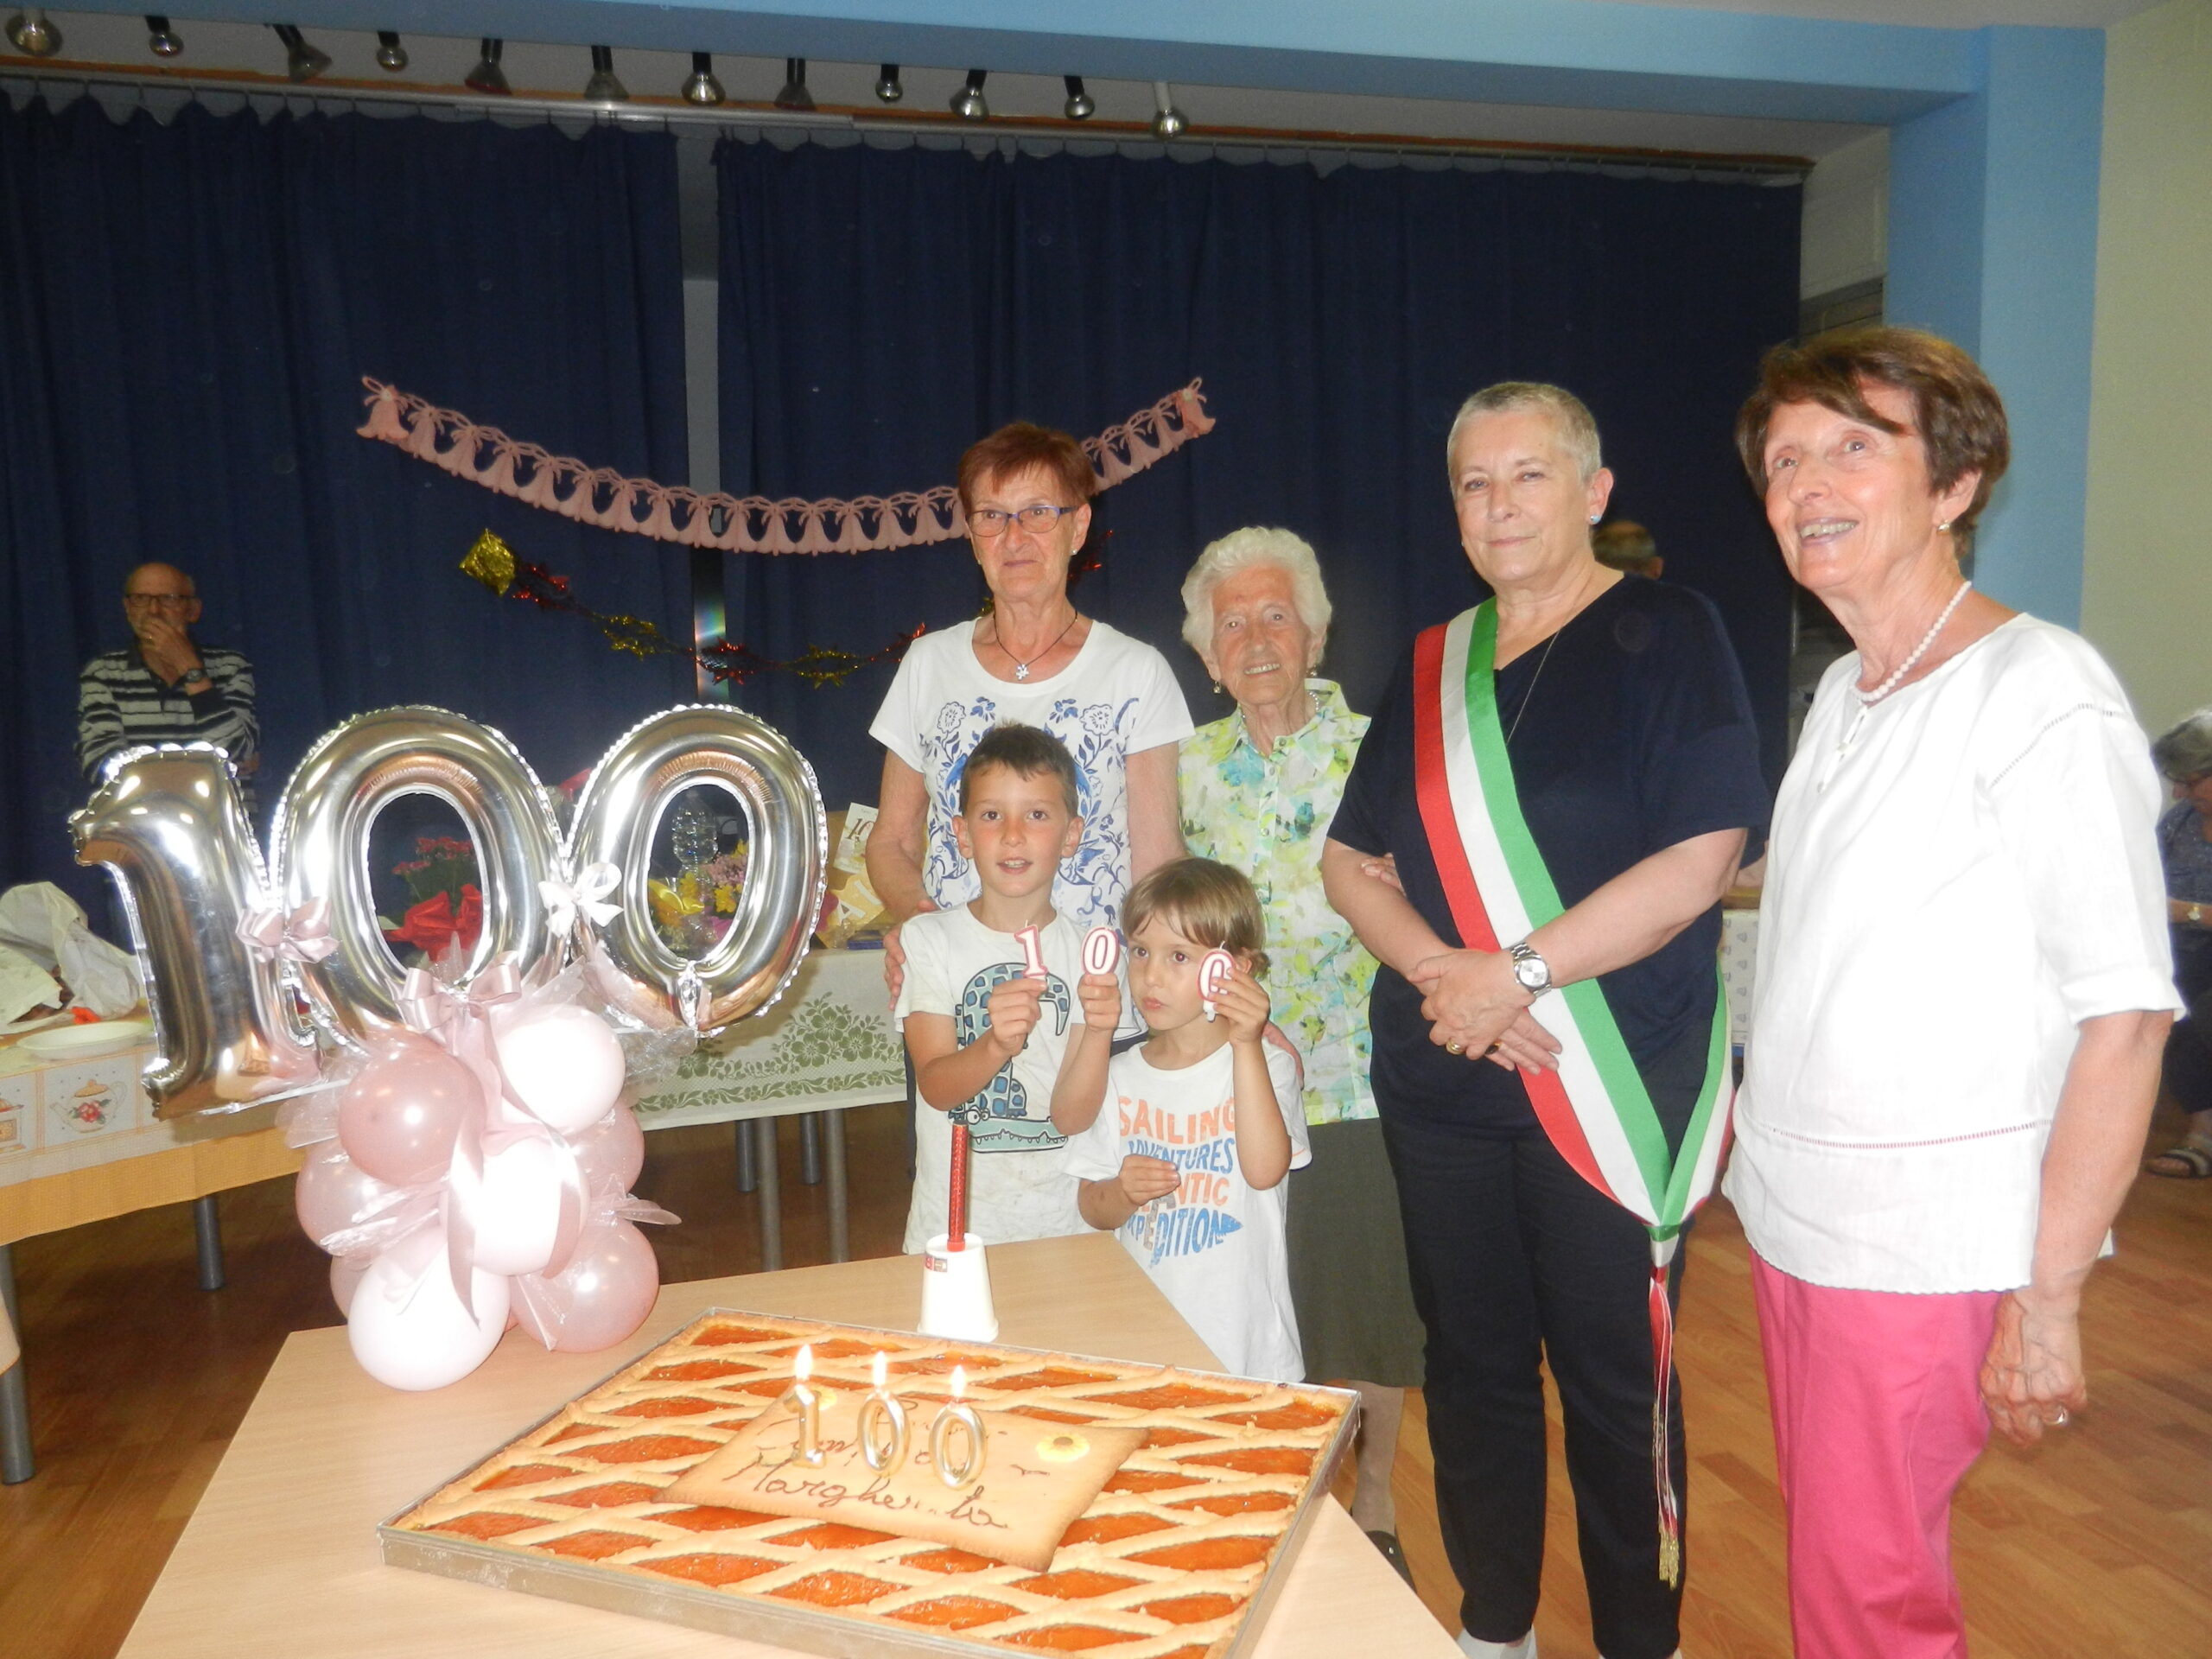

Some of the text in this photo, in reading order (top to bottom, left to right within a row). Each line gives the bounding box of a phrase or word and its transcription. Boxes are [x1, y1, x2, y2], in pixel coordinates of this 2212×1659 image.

[69, 702, 828, 1122] 100
[1119, 1096, 1235, 1145] SAILING
[1127, 1207, 1230, 1260] XPEDITION
[783, 1382, 988, 1489] 100
